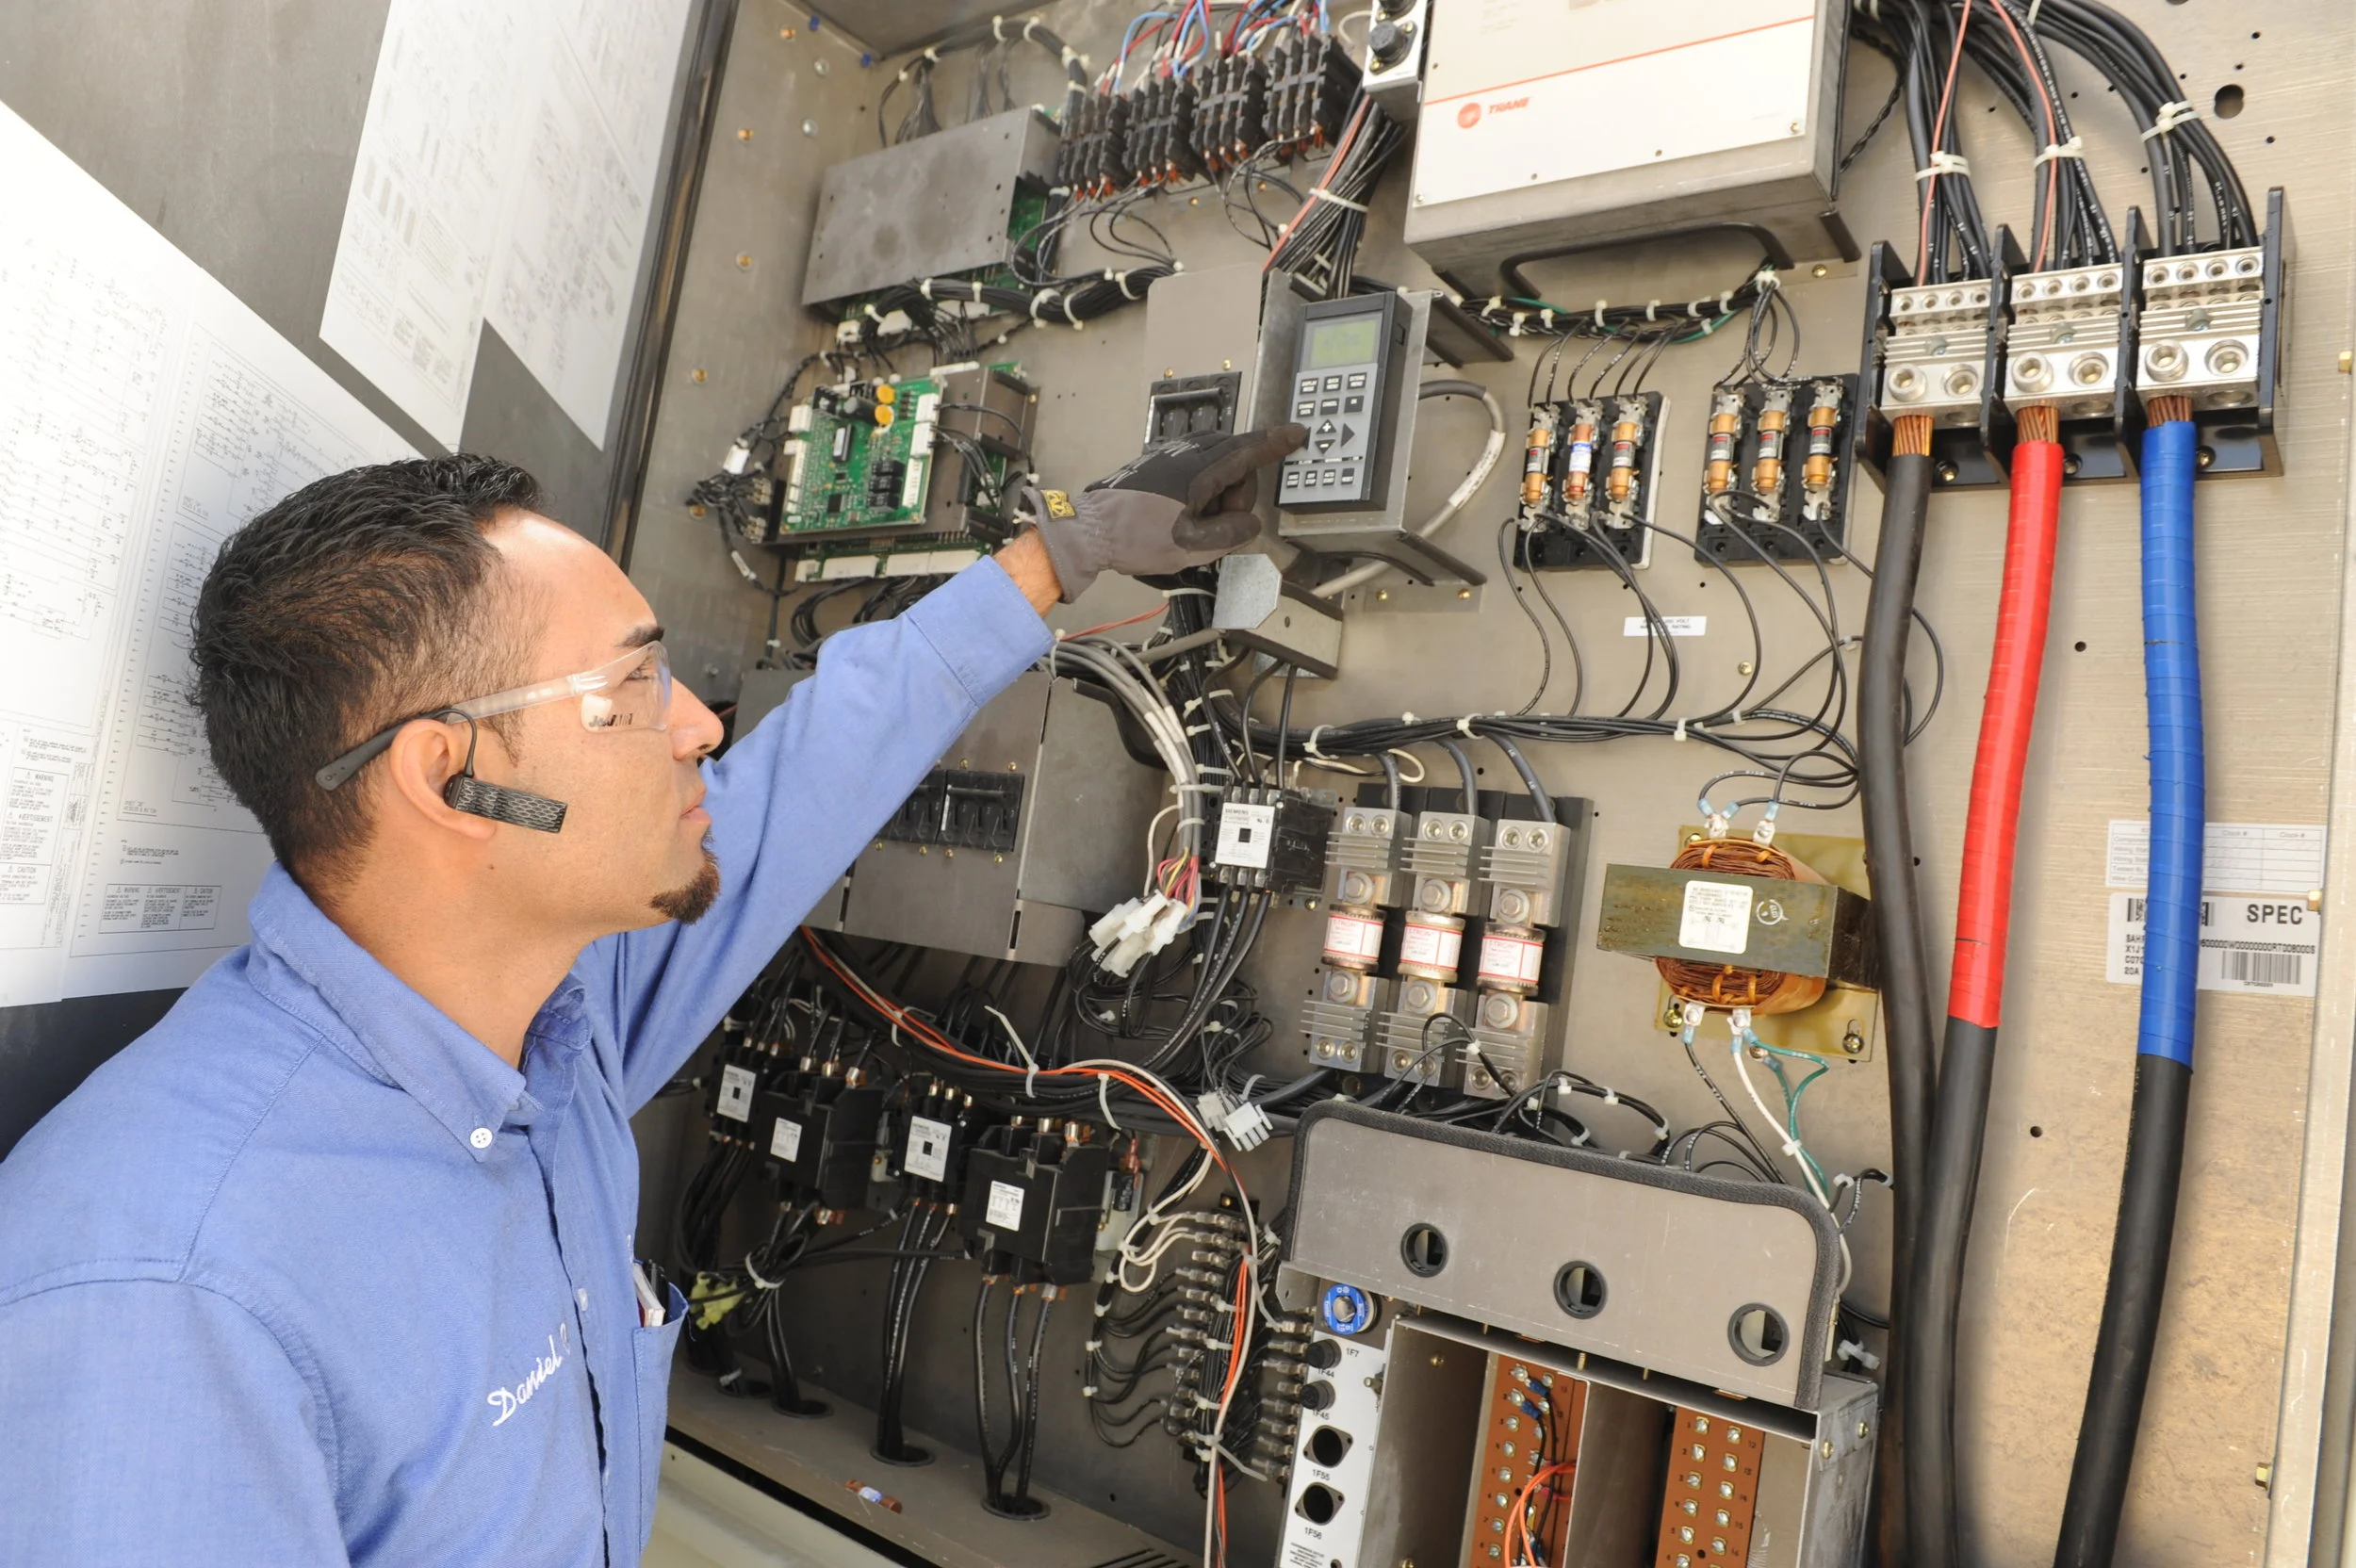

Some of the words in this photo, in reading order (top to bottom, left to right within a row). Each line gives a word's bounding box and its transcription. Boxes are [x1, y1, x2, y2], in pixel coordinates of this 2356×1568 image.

[1489, 97, 1530, 114] TRANE
[2247, 904, 2302, 924] SPEC
[1346, 1348, 1360, 1358] 1F7
[1317, 1368, 1335, 1378] 1F44
[487, 1334, 563, 1427] Daniel
[1313, 1410, 1330, 1420] 1F45
[1313, 1468, 1330, 1481] 1F55
[1304, 1527, 1322, 1540] 1F56
